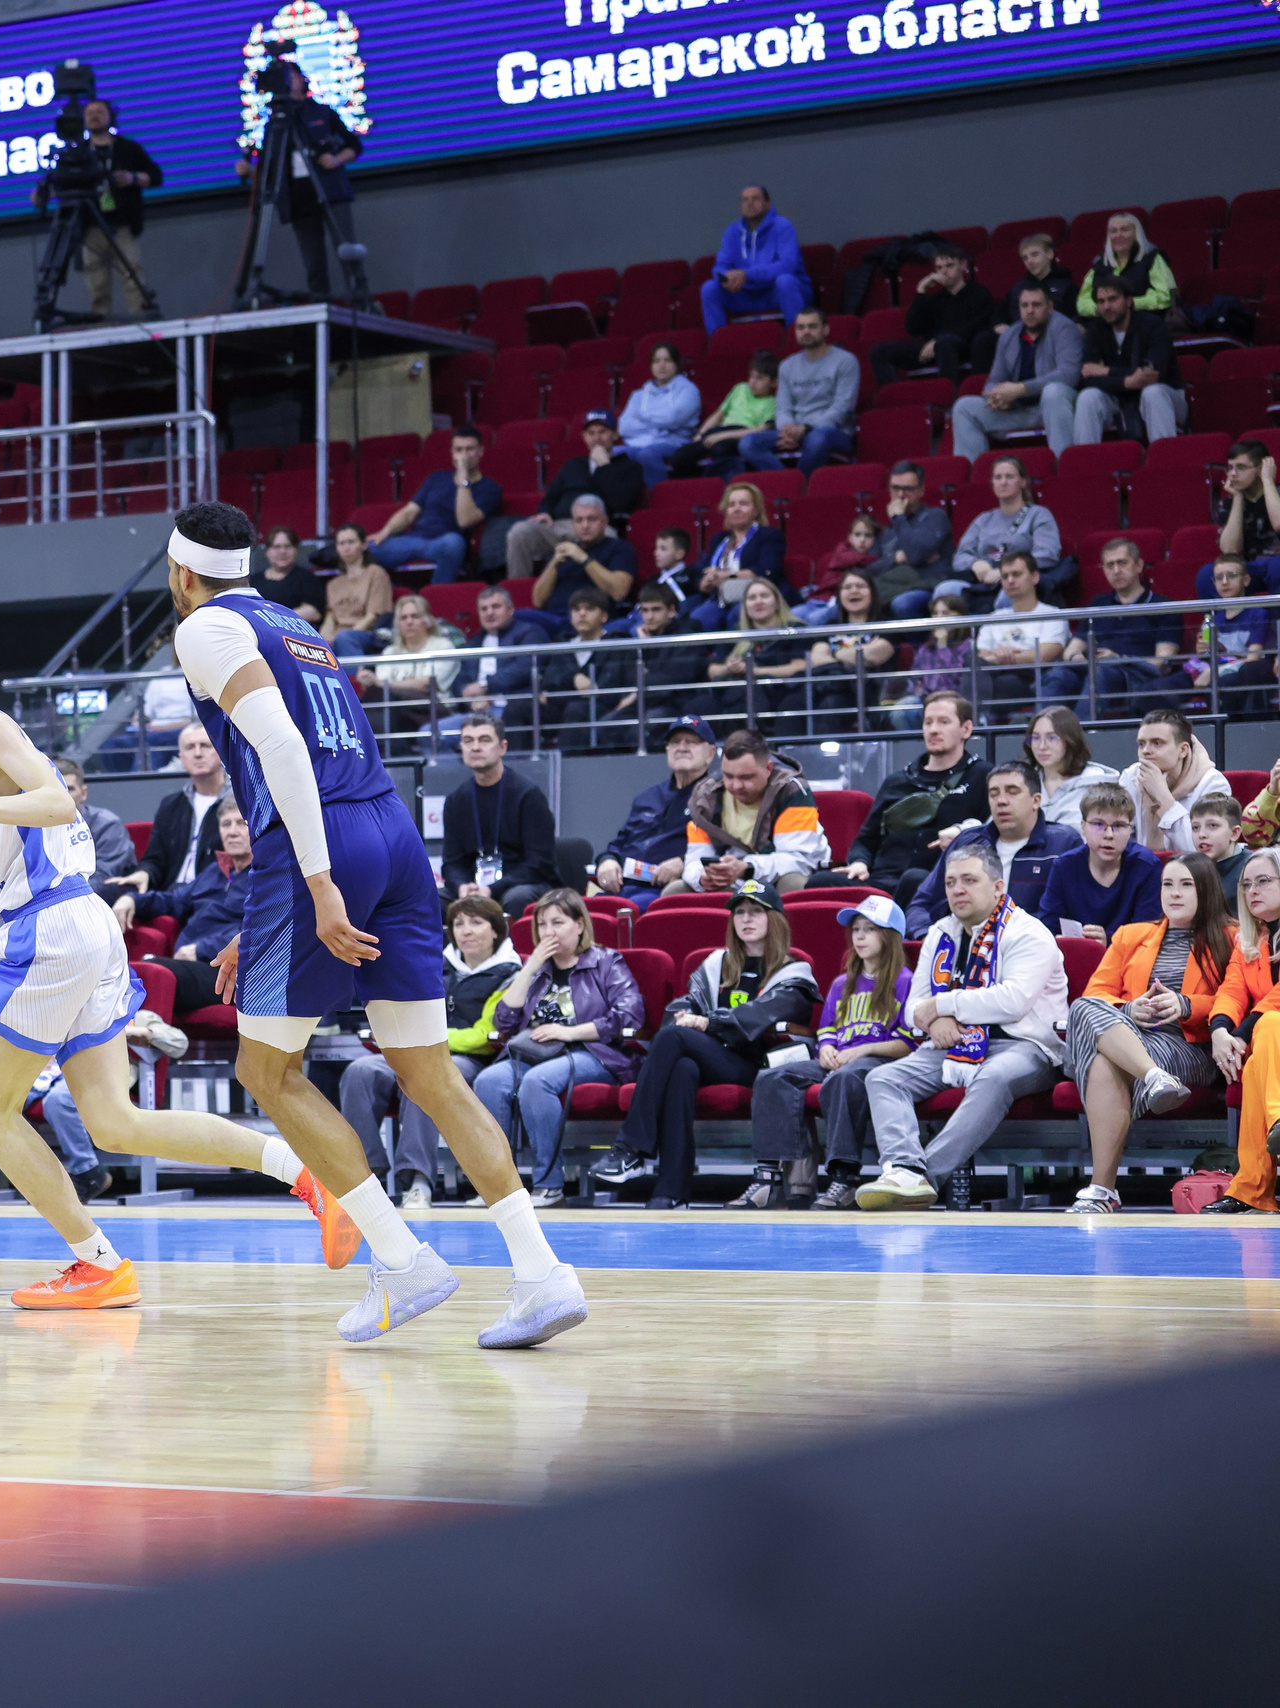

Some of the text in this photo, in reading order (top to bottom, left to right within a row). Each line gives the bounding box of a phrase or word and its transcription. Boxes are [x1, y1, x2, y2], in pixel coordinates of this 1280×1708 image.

[496, 10, 826, 104] Самарской
[846, 0, 1100, 55] области
[286, 639, 328, 664] WINLINE
[301, 671, 365, 757] 00
